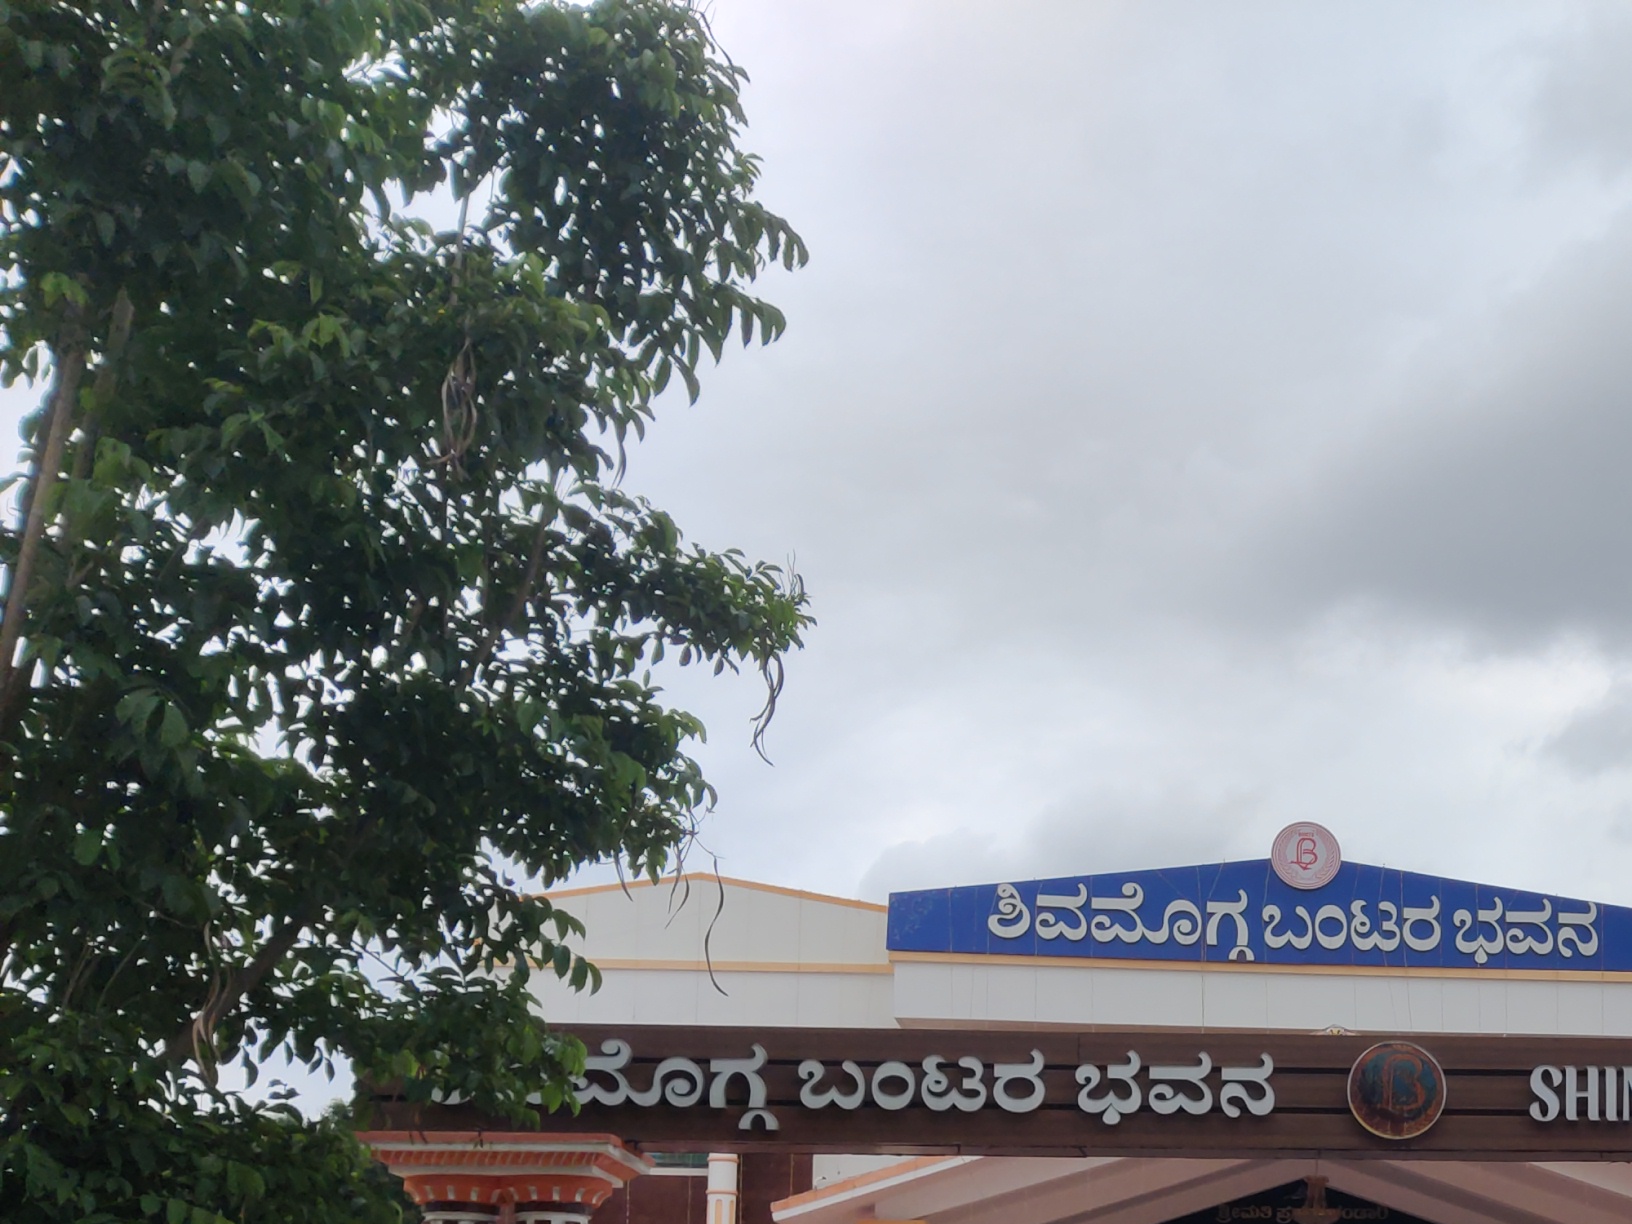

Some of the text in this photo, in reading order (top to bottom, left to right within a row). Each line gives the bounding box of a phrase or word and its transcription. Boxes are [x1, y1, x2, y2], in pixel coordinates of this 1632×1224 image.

[987, 882, 1599, 965] ಶಿವಮೊಗ್ಗ ಬಂಟರ ಭವನ
[797, 1047, 1046, 1114] ಬಂಟರ
[1075, 1048, 1276, 1126] ಭವನ
